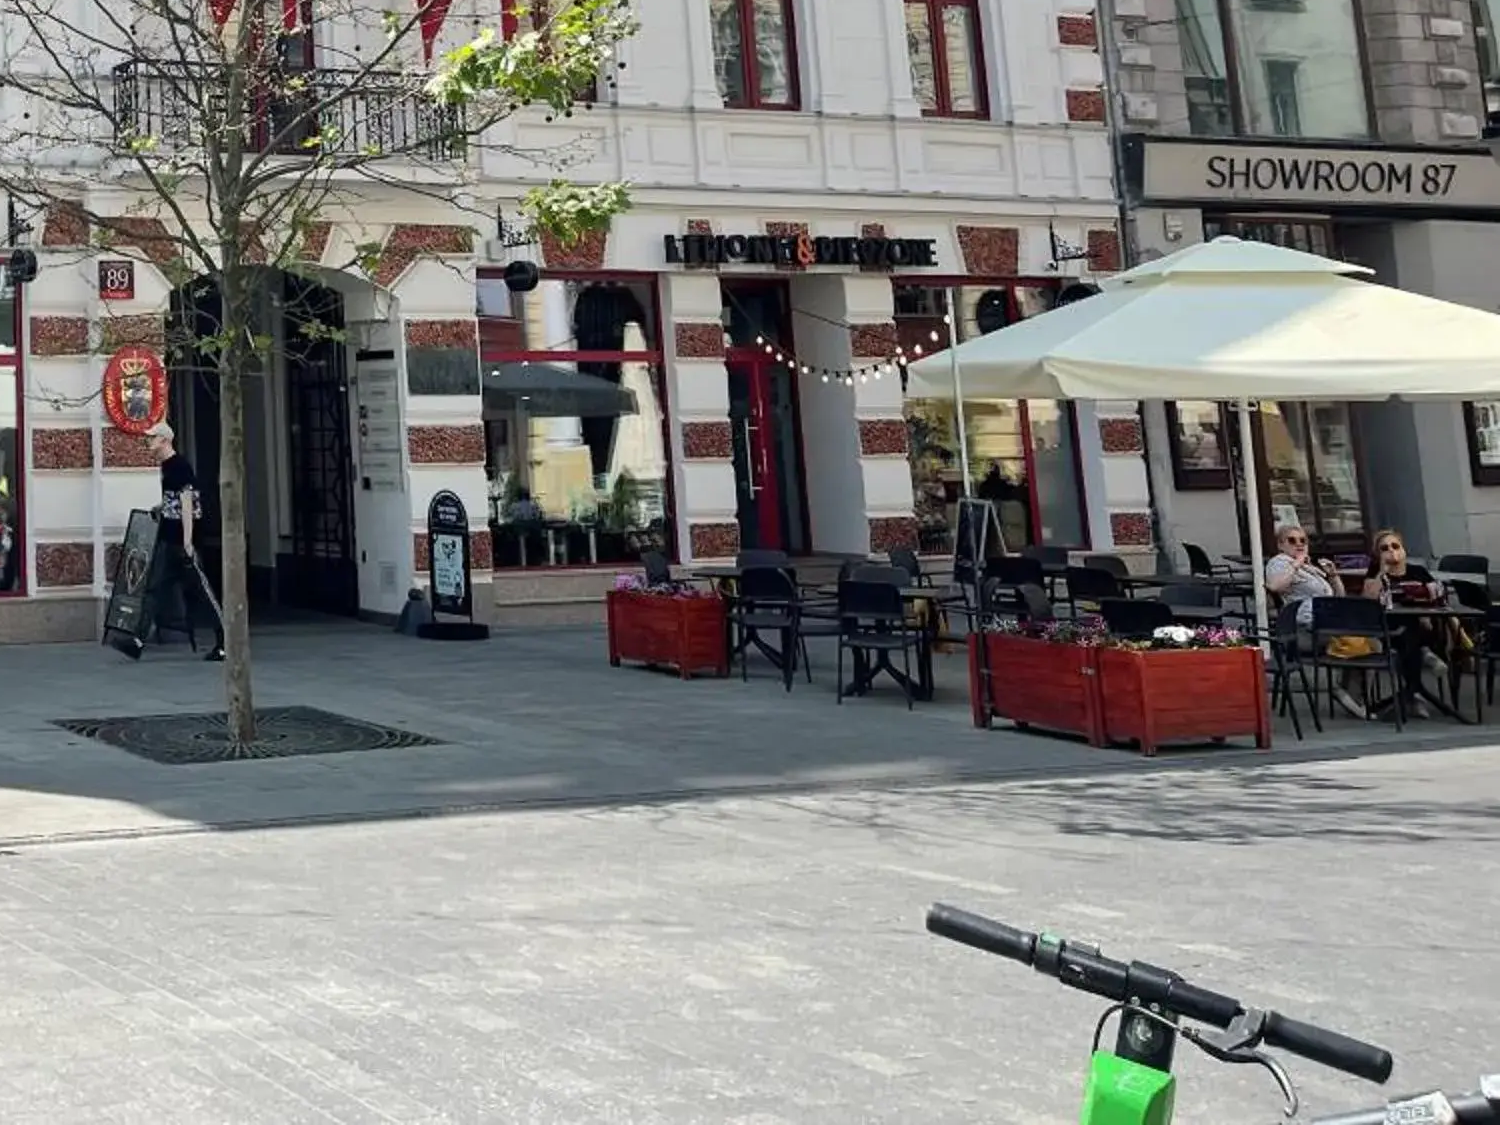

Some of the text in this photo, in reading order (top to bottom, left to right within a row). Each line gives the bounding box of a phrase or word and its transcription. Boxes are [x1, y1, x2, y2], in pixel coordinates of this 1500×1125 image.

[1206, 156, 1457, 196] SHOWROOM 87
[107, 268, 129, 290] 89
